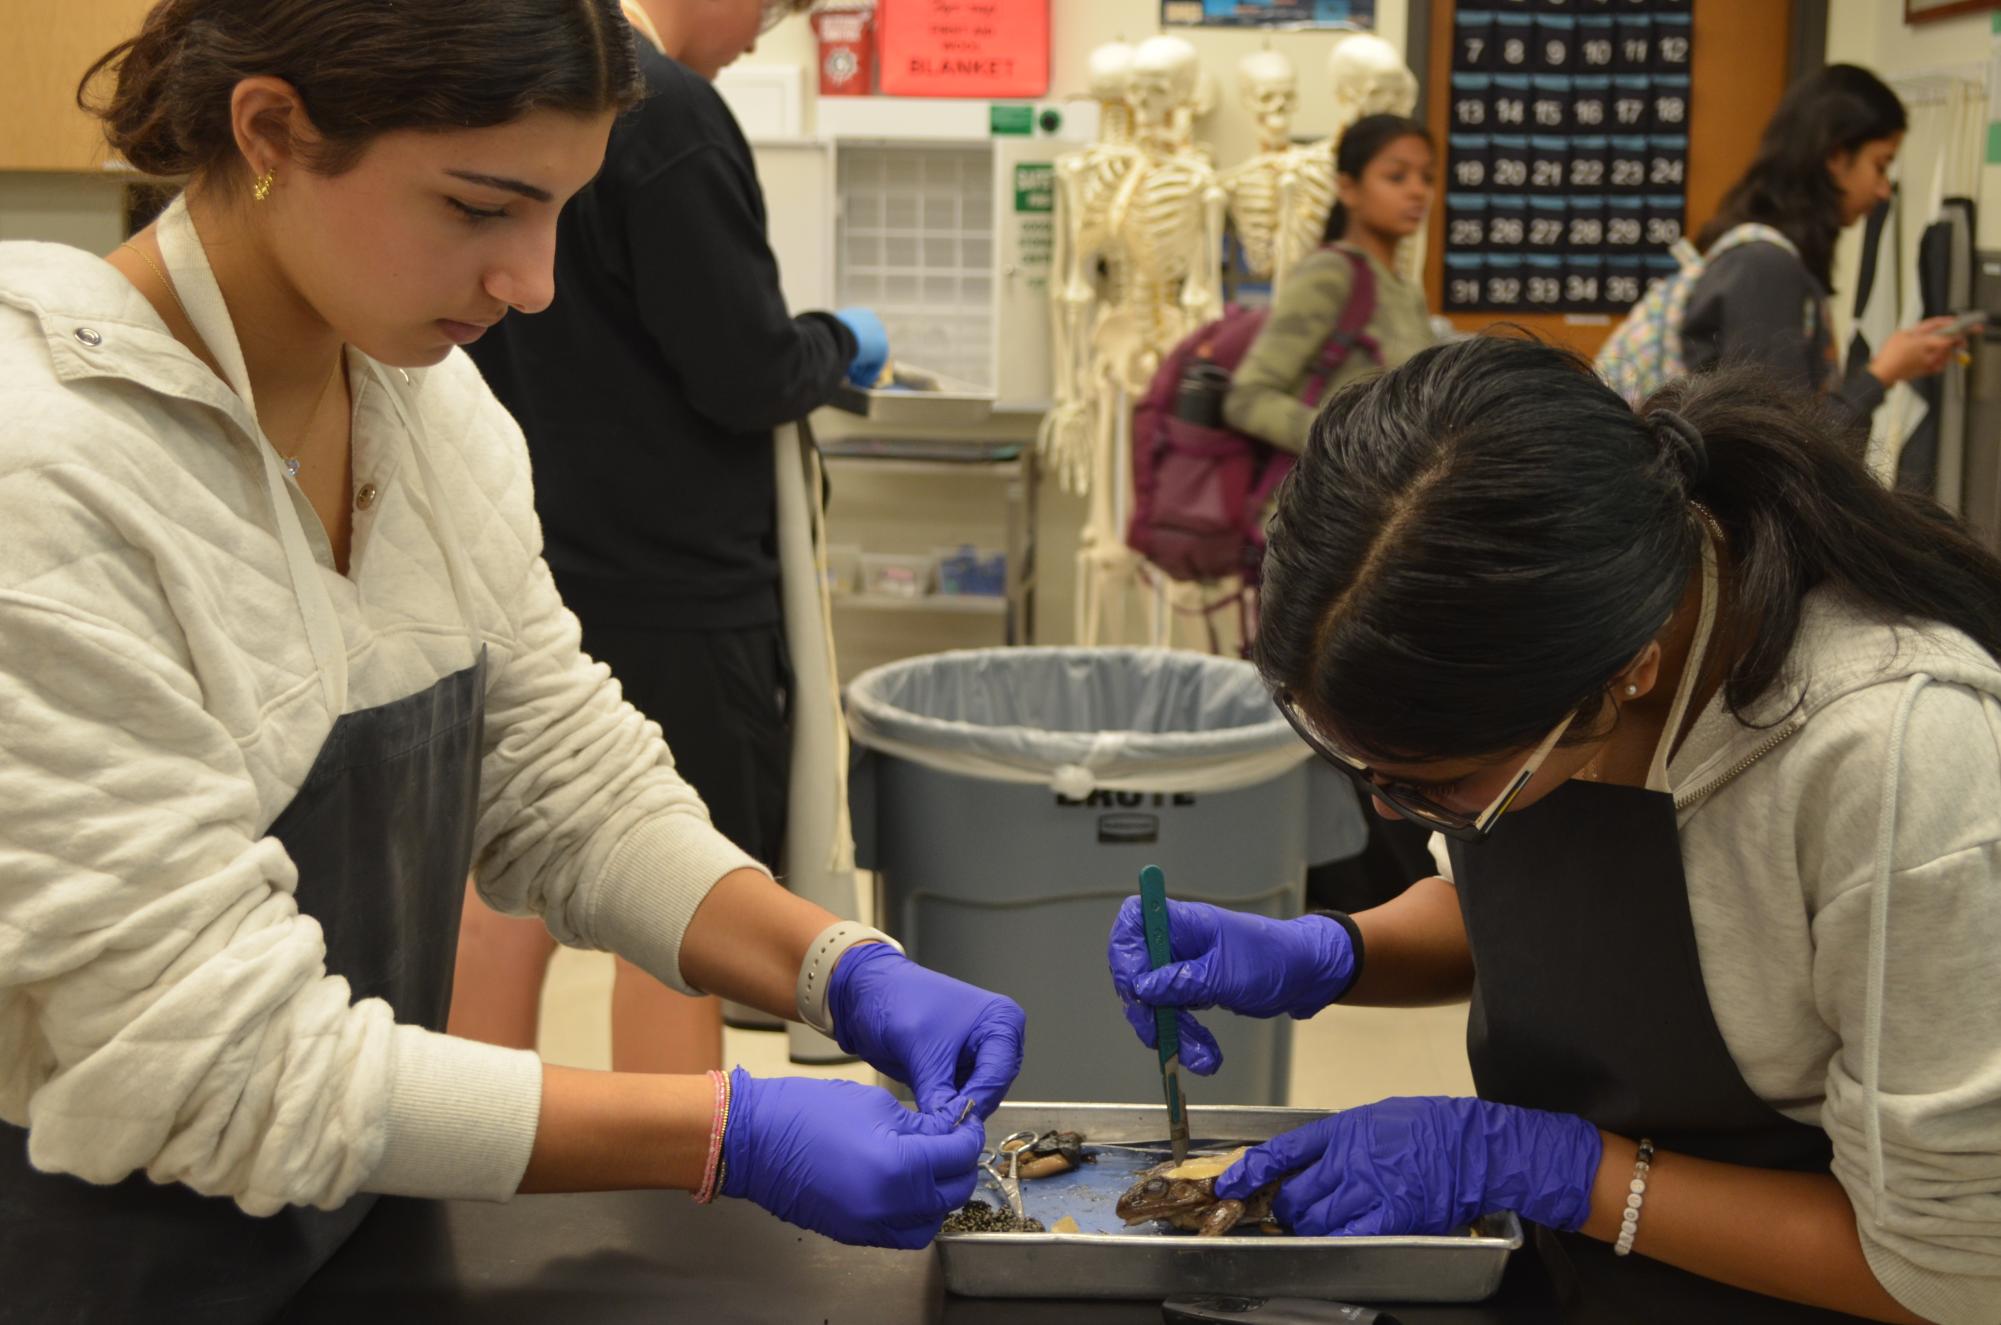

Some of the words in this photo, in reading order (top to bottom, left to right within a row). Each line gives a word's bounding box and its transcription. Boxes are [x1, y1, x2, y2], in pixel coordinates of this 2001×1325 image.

[1466, 38, 1484, 62] 7
[1504, 39, 1524, 63] 8
[1546, 40, 1565, 65] 9
[1584, 40, 1611, 64] 10
[1624, 39, 1647, 62] 11
[1660, 37, 1688, 62] 12
[910, 58, 1015, 75] BLANKET
[1457, 100, 1484, 124] 13
[1496, 99, 1523, 123] 14
[1534, 100, 1561, 125] 15
[1575, 100, 1603, 124] 16
[1616, 99, 1643, 123] 17
[1456, 161, 1484, 185] 19
[1494, 159, 1526, 185] 20
[1532, 160, 1562, 186] 21
[1570, 159, 1603, 185] 22
[1611, 159, 1644, 185] 23
[1651, 158, 1683, 183] 24
[1451, 220, 1483, 244] 25
[1490, 218, 1523, 244] 26
[1530, 218, 1562, 244] 27
[1570, 219, 1602, 244] 28
[1607, 218, 1641, 244] 29
[1646, 218, 1681, 244] 30
[1452, 279, 1479, 302] 31
[1490, 278, 1520, 302] 32
[1527, 277, 1559, 302] 33
[1567, 275, 1597, 300] 34
[1605, 275, 1639, 302] 35
